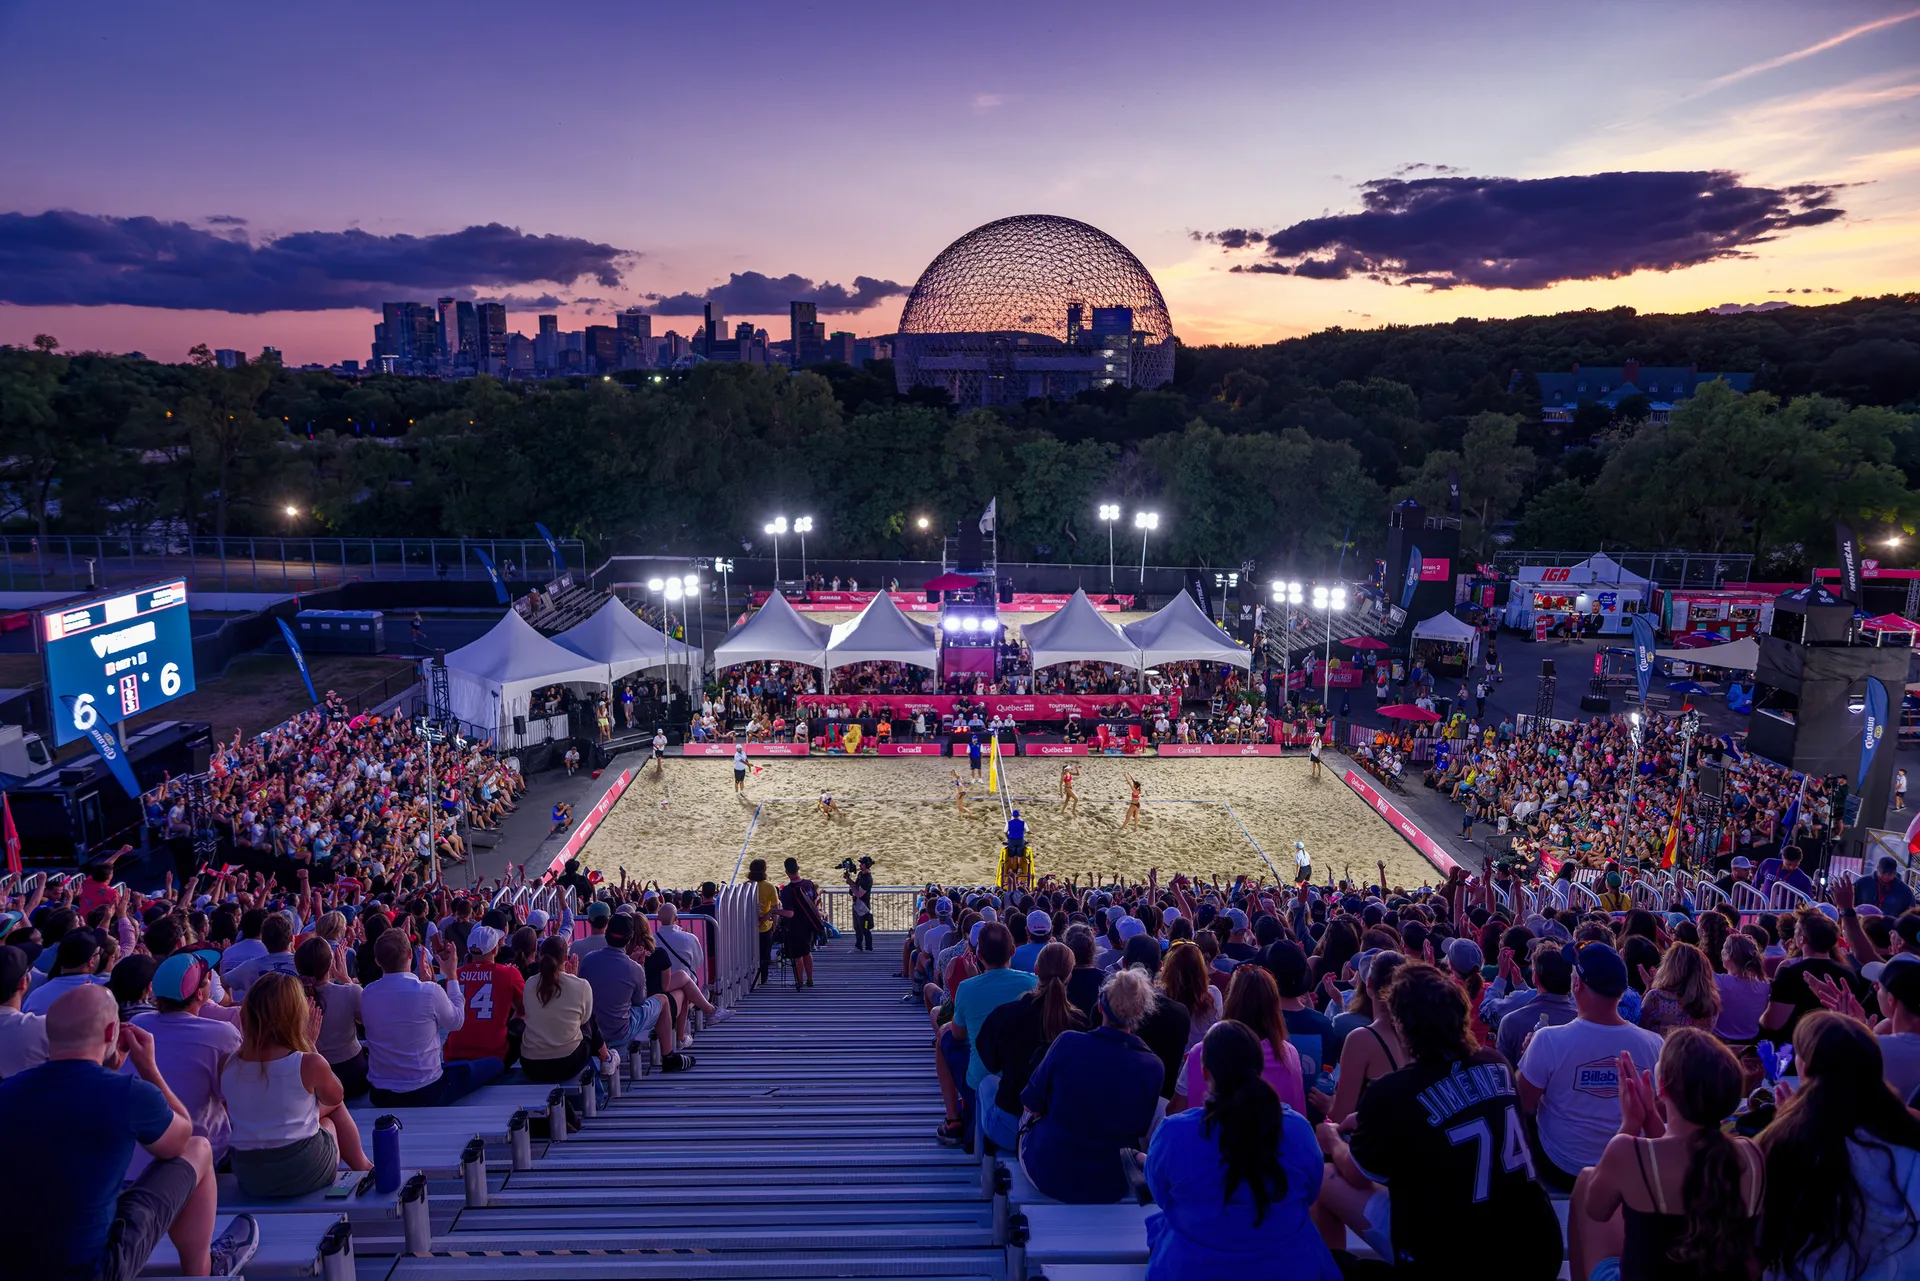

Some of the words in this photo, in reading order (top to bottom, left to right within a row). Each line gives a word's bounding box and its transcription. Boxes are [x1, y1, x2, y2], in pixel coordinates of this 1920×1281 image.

[1541, 568, 1571, 581] IGA
[1843, 541, 1857, 592] MONTRÉAL
[160, 662, 181, 696] 6
[73, 693, 97, 730] 6
[996, 703, 1024, 712] Québec
[460, 971, 493, 981] SUZUKI
[459, 983, 494, 1020] 4
[1416, 1060, 1517, 1127] JIMÉNEZ
[1580, 1070, 1619, 1082] Billab
[1445, 1104, 1536, 1203] 74
